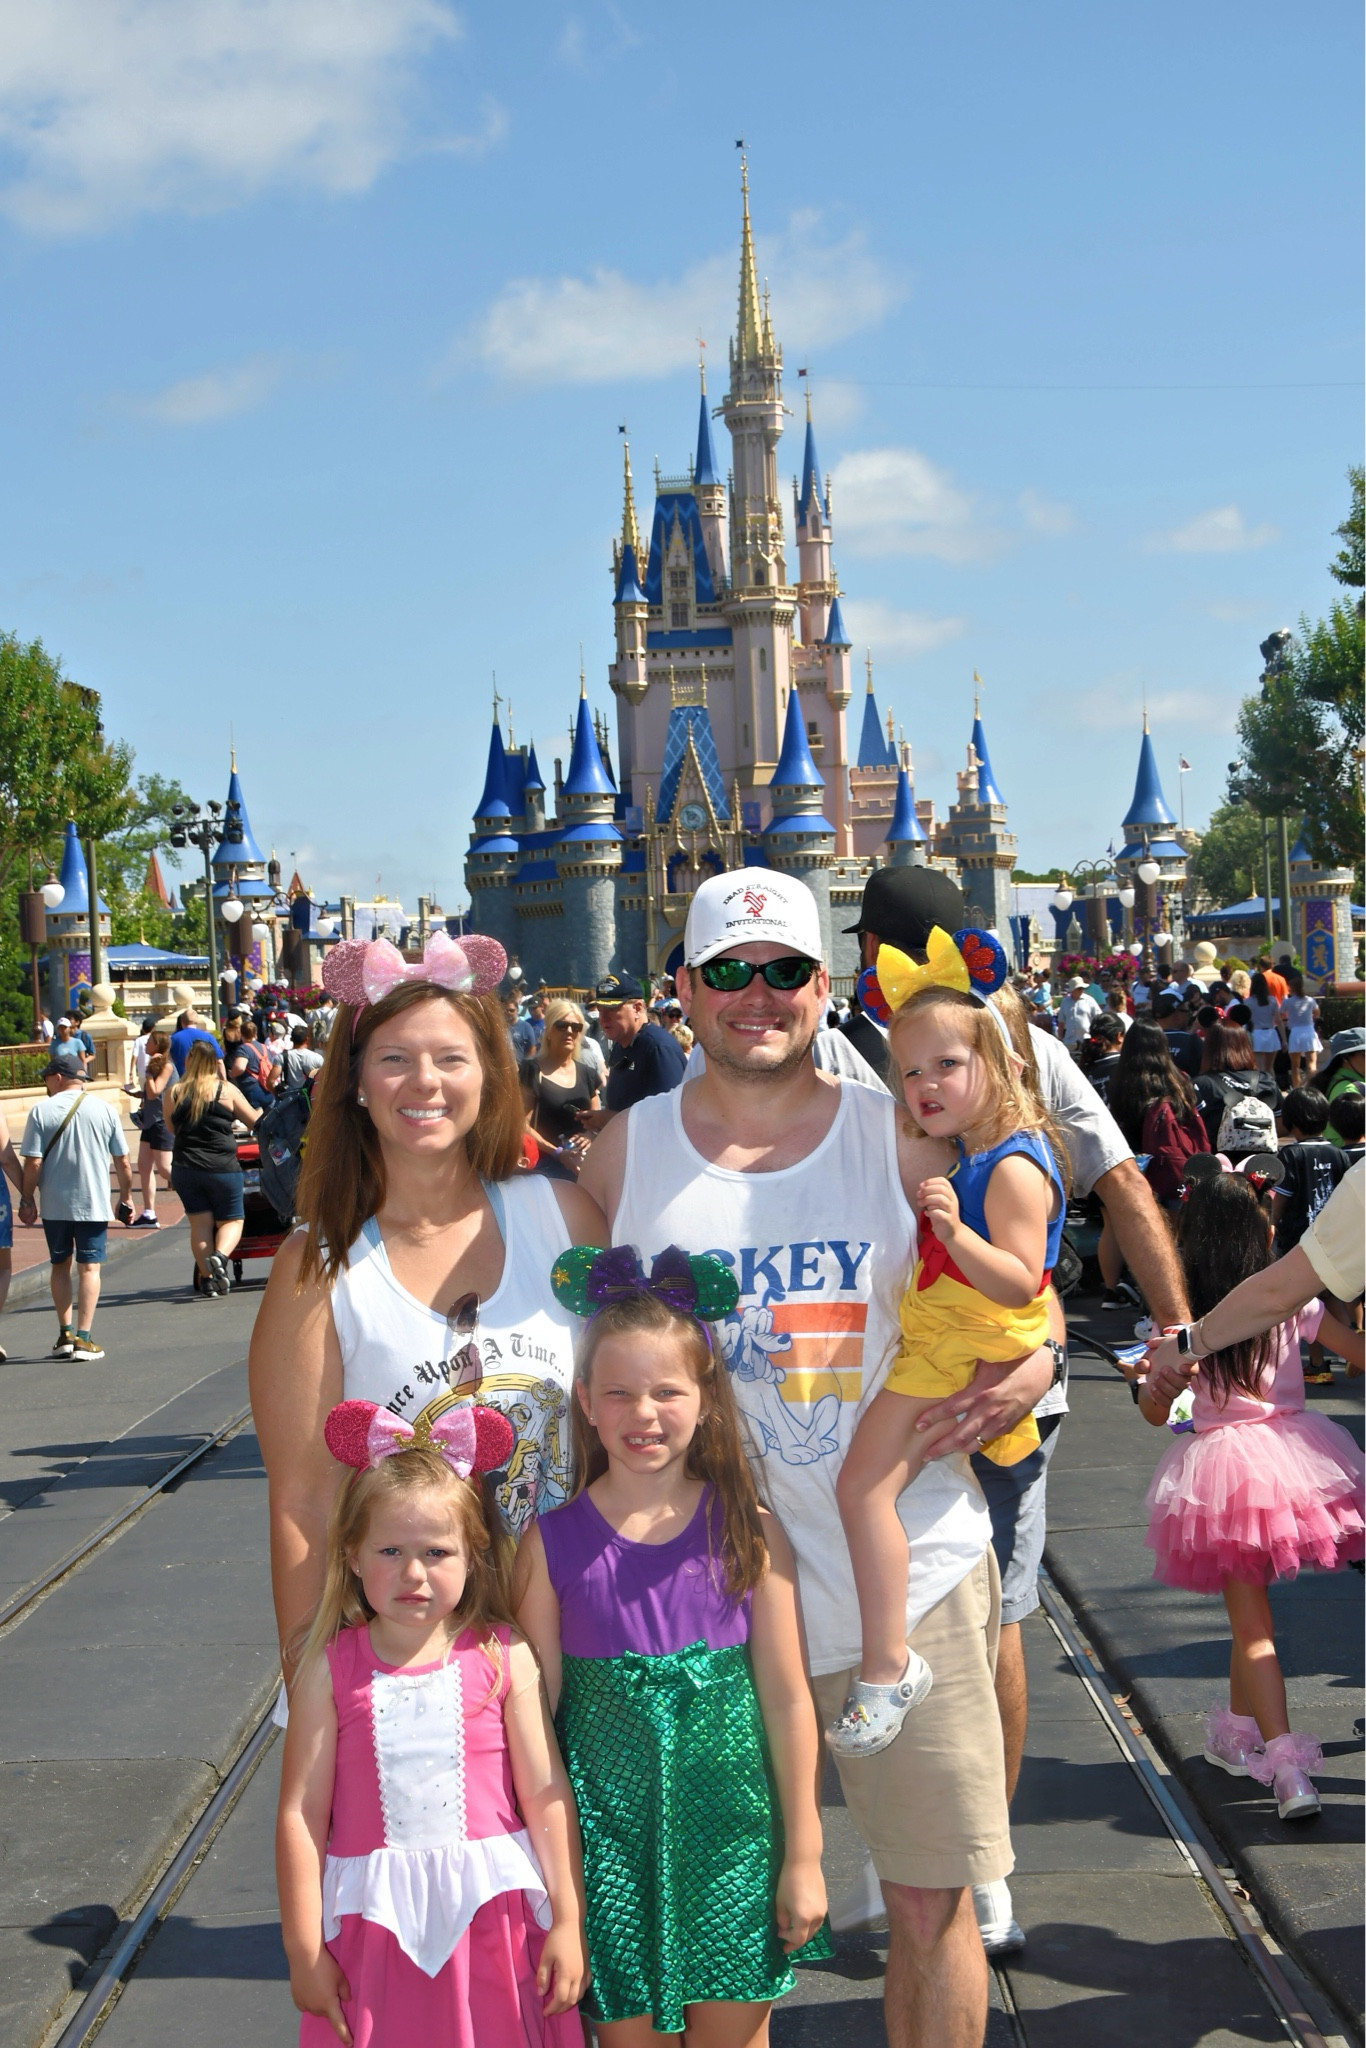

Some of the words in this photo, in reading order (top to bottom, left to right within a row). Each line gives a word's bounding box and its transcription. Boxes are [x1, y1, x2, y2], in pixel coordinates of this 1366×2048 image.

[723, 887, 744, 905] DEAD
[746, 884, 789, 904] STRAIGHT
[726, 918, 789, 929] INVITATIONAL
[651, 1240, 871, 1296] KEY
[386, 1384, 415, 1416] nce
[413, 1348, 474, 1385] Upon
[482, 1337, 504, 1370] A
